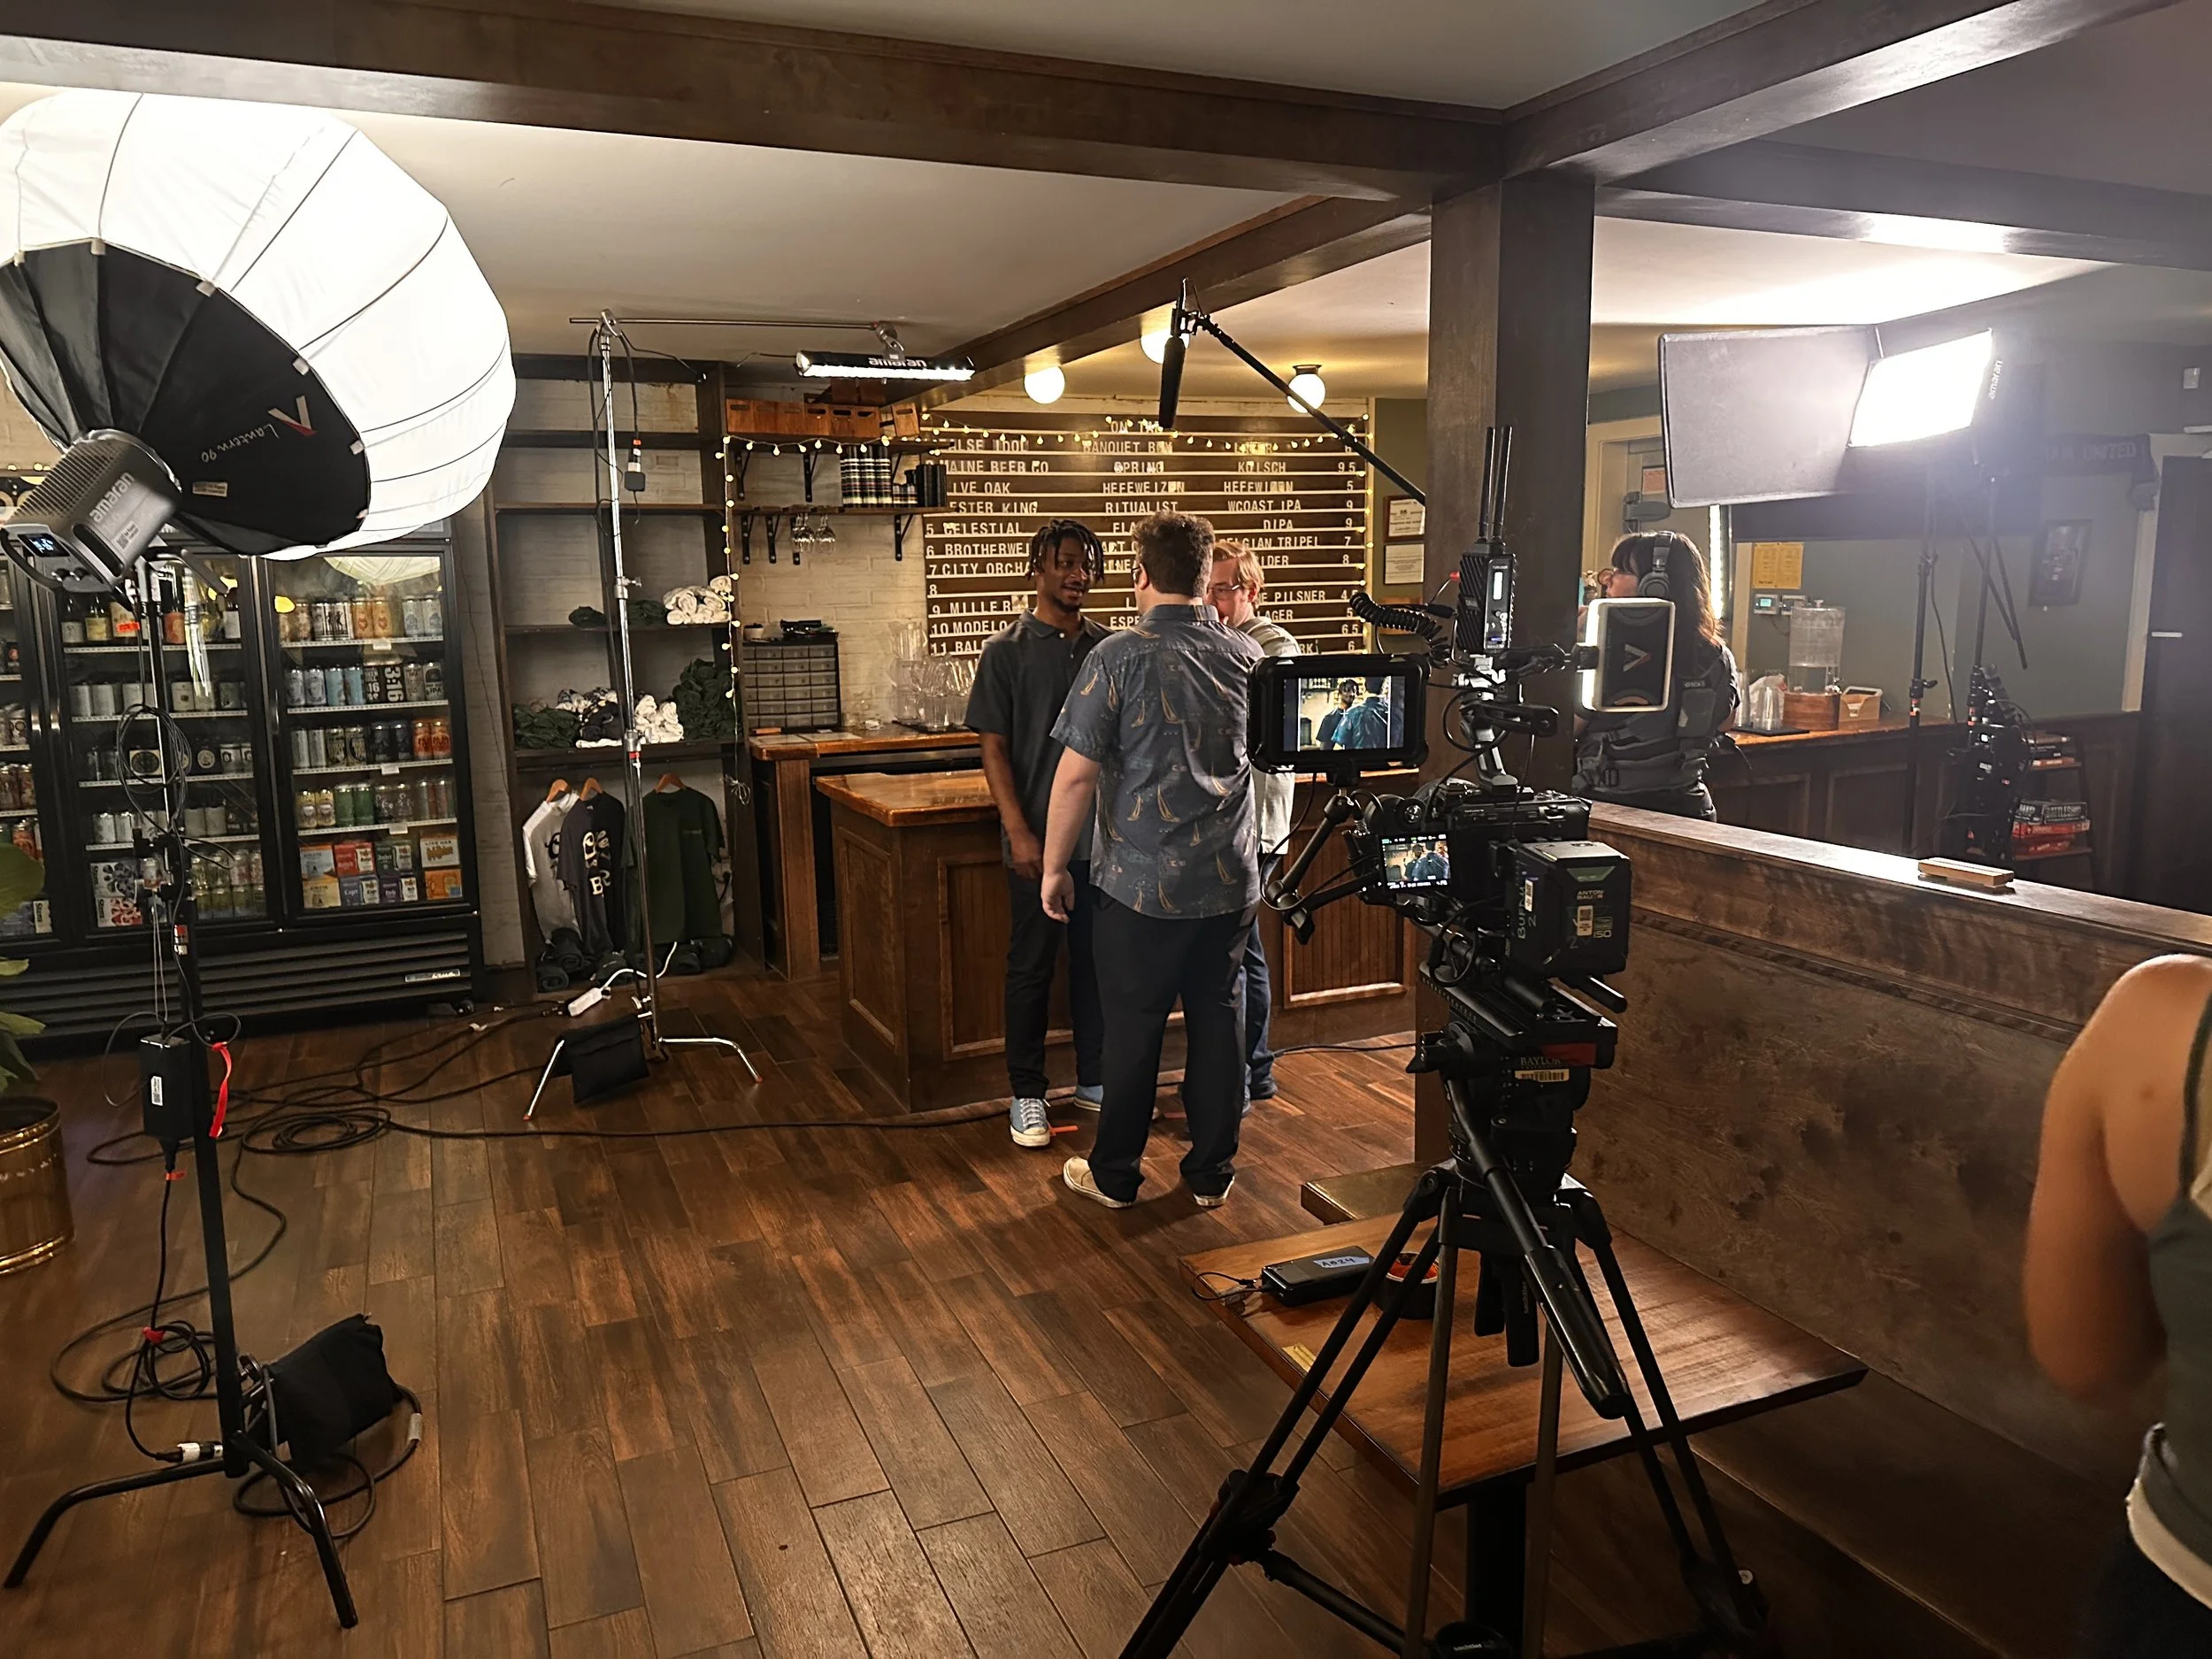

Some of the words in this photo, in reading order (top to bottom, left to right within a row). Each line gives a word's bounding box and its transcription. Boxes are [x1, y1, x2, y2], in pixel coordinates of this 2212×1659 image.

[868, 357, 927, 368] amaran
[1111, 421, 1127, 434] ON
[218, 424, 280, 452] Lantern
[948, 439, 984, 452] ALSE
[995, 440, 1028, 452] IDOL
[1082, 442, 1140, 453] BANQUET
[201, 449, 217, 463] 90
[991, 460, 1025, 472] BEER
[952, 481, 977, 494] IVE
[985, 481, 1010, 494] OAK
[1347, 480, 1354, 491] 5
[89, 472, 135, 523] amaran
[949, 501, 994, 513] ESTER
[1002, 502, 1038, 513] KING
[1105, 502, 1178, 513] RITUALIST
[1227, 500, 1274, 511] WCOAST
[1281, 499, 1302, 511] IPA
[1346, 500, 1353, 510] 9
[926, 524, 934, 534] 5
[943, 522, 1020, 534] CELESTIAL
[1263, 518, 1294, 530] DIPA
[1345, 518, 1353, 528] 9
[1278, 535, 1318, 548] TRIPEL
[1344, 536, 1351, 546] 7
[926, 545, 934, 557] 6
[945, 542, 1030, 556] BROTHERWEL
[1342, 554, 1349, 565] 8
[929, 564, 937, 575] 7
[941, 563, 979, 575] CITY
[987, 562, 1030, 574] ORCHA
[929, 584, 937, 595] 8
[1274, 590, 1325, 602] PILSNER
[932, 604, 941, 615] 9
[949, 601, 1010, 614] MILLER
[1347, 608, 1353, 618] 5
[1257, 609, 1294, 620] LAGER
[932, 623, 949, 635] 10
[953, 620, 1008, 634] MODELO
[932, 642, 947, 655] 11
[1348, 641, 1355, 651] 6
[384, 666, 404, 703] 3:16
[1520, 1056, 1562, 1066] BAYLOR
